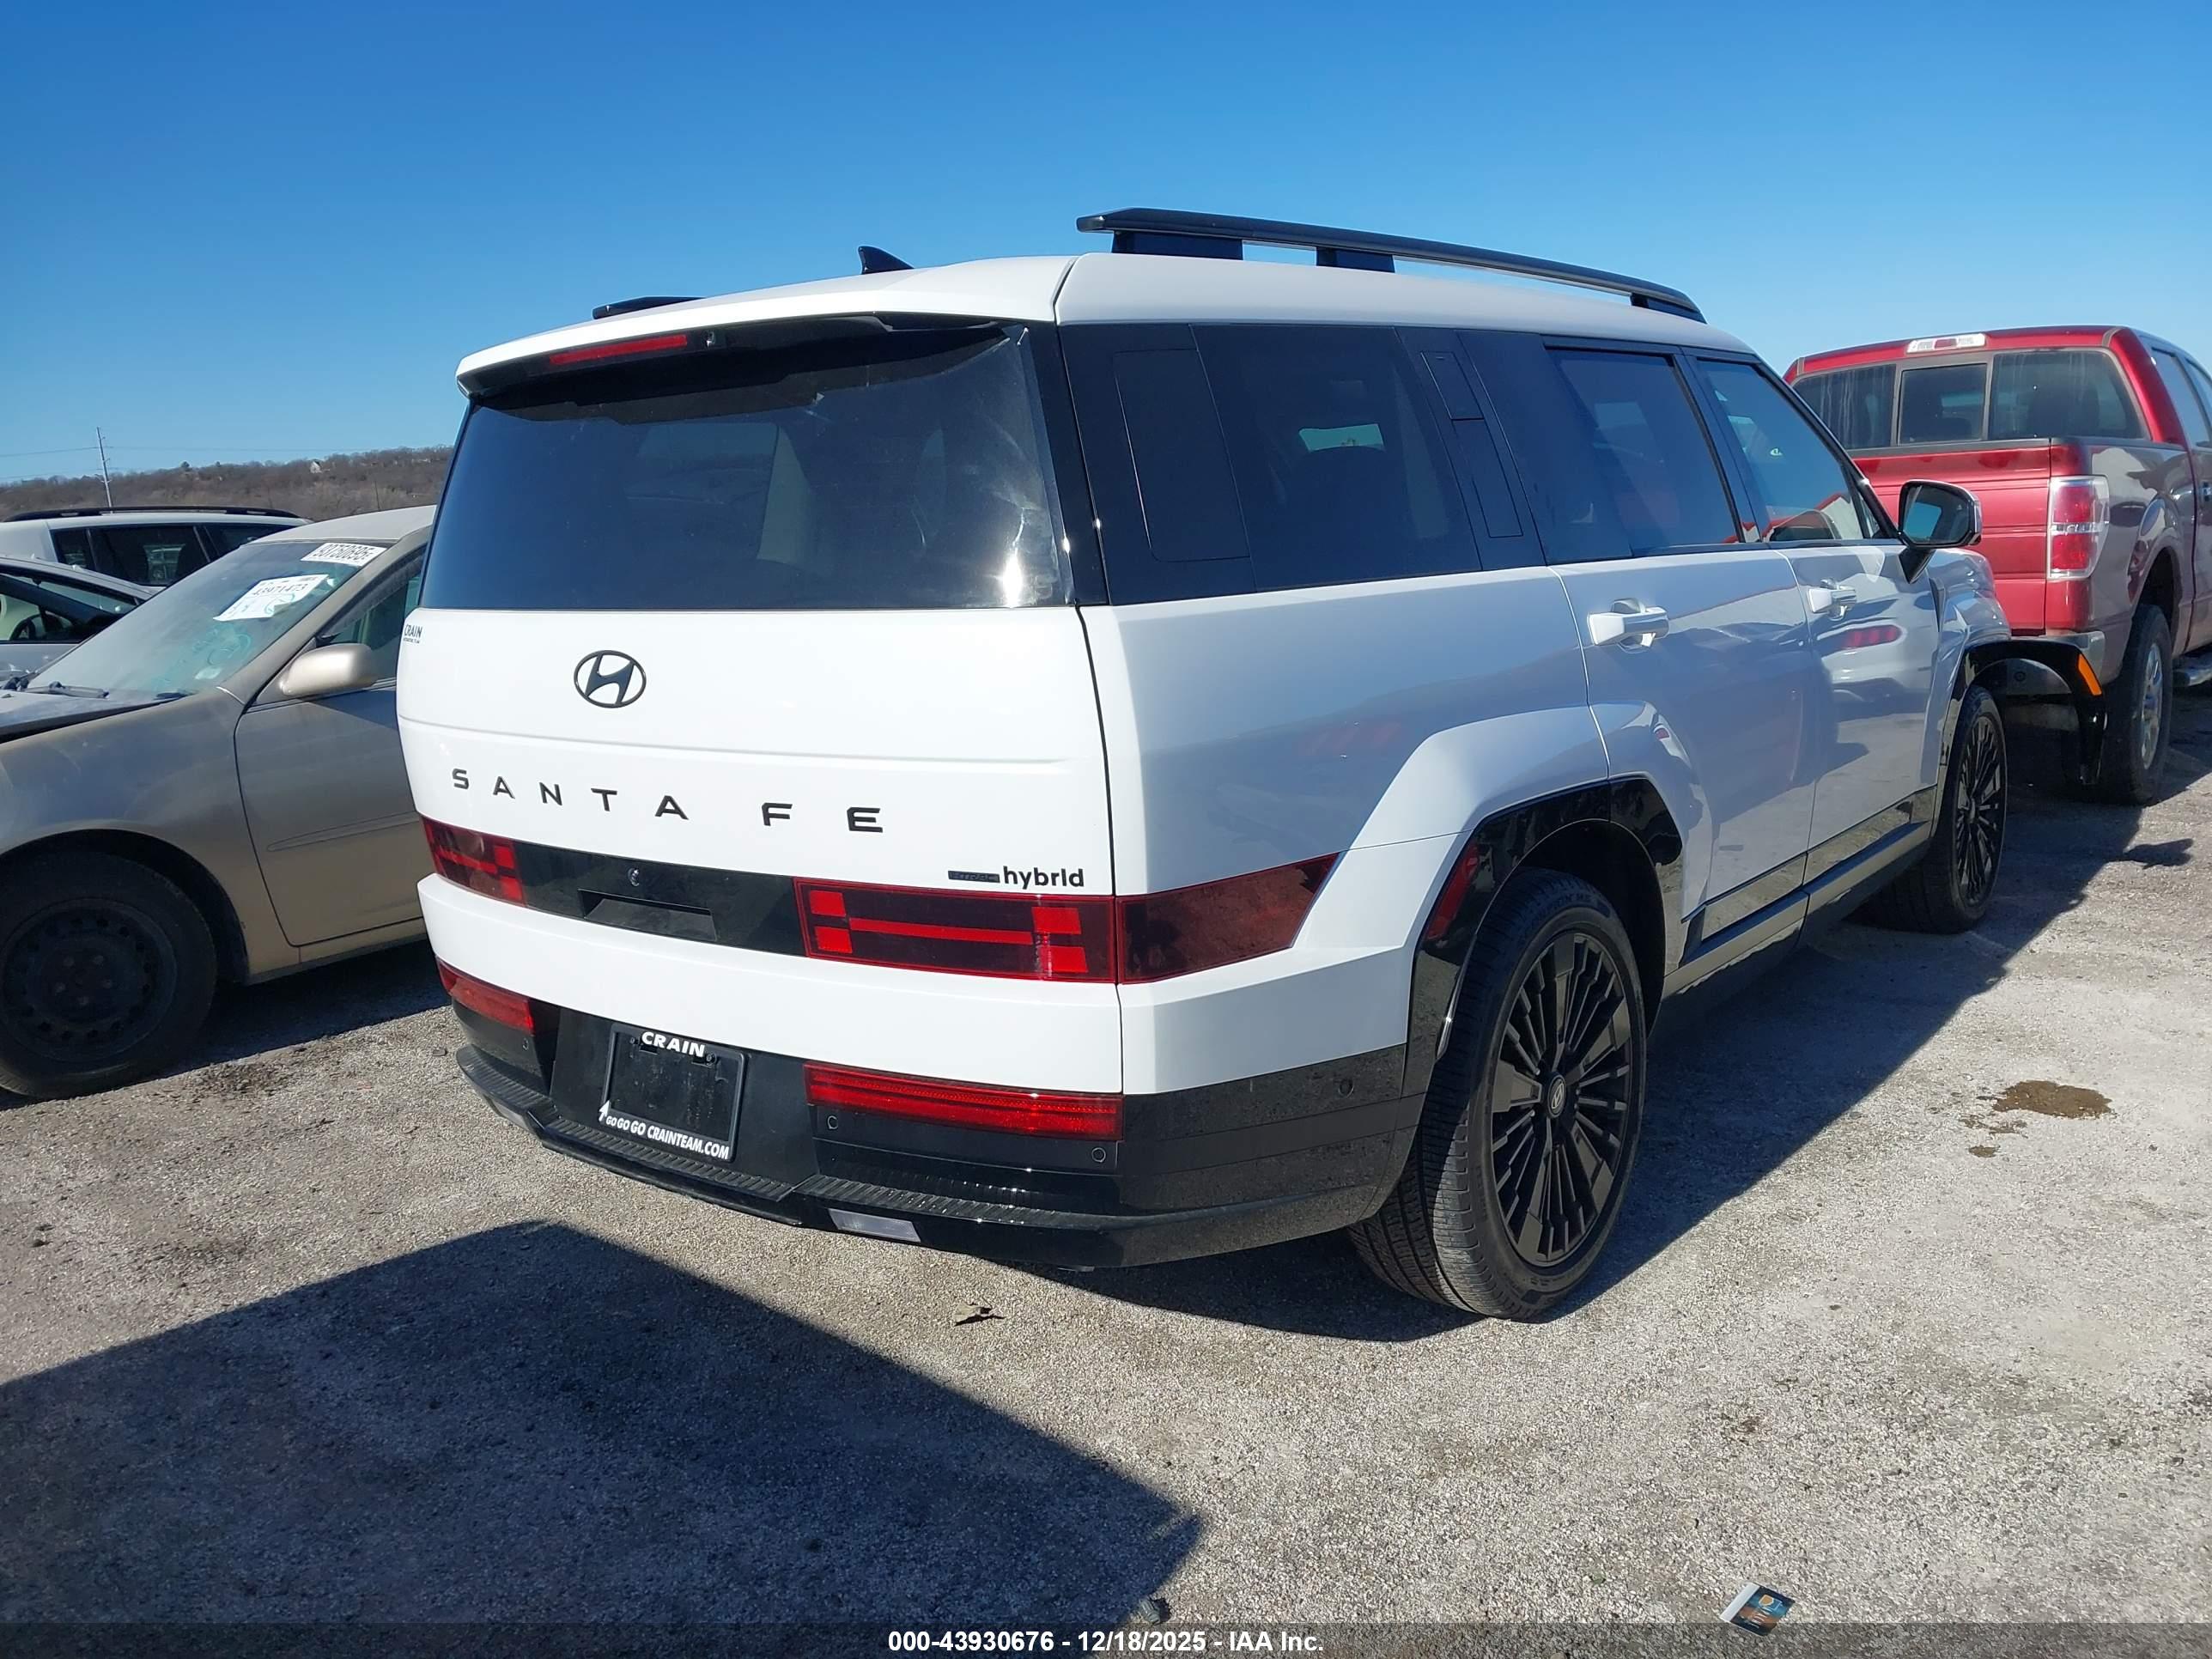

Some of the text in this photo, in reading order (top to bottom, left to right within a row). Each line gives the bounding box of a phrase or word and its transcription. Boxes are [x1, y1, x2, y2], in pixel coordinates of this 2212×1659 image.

[404, 623, 423, 639] CRAIN
[451, 768, 884, 834] SANTA FE
[1003, 865, 1085, 890] hybrid
[641, 1031, 706, 1058] CRAIN
[605, 1115, 730, 1160] GO GO GO CRAINTEAM.COM
